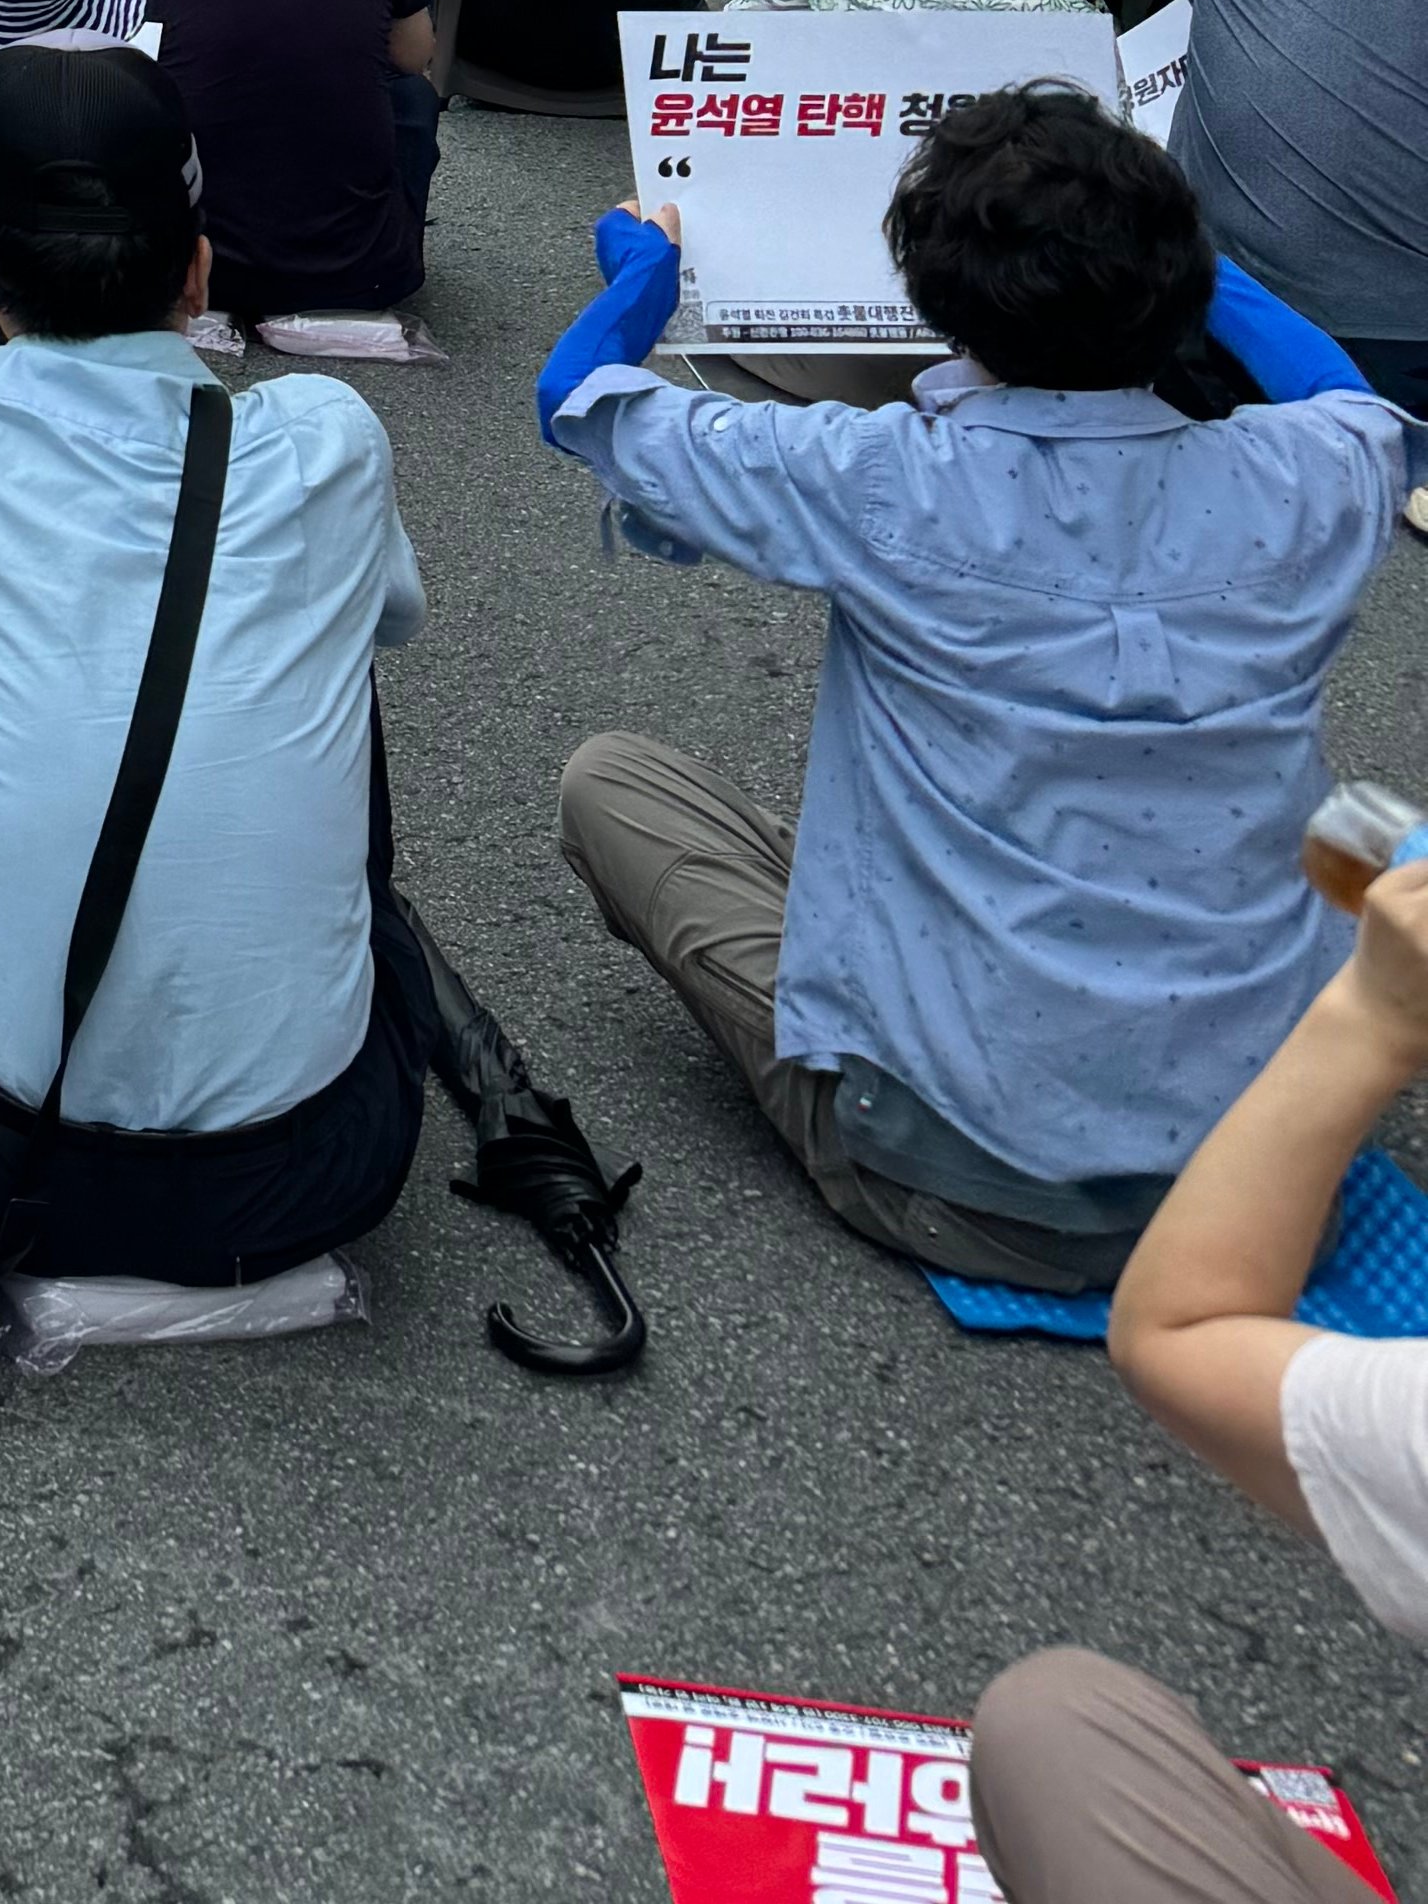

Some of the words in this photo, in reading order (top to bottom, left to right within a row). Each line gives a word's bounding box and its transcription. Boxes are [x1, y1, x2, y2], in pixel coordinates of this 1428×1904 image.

[649, 32, 752, 84] 나는
[650, 93, 784, 139] 윤석열
[795, 91, 887, 138] 탄핵
